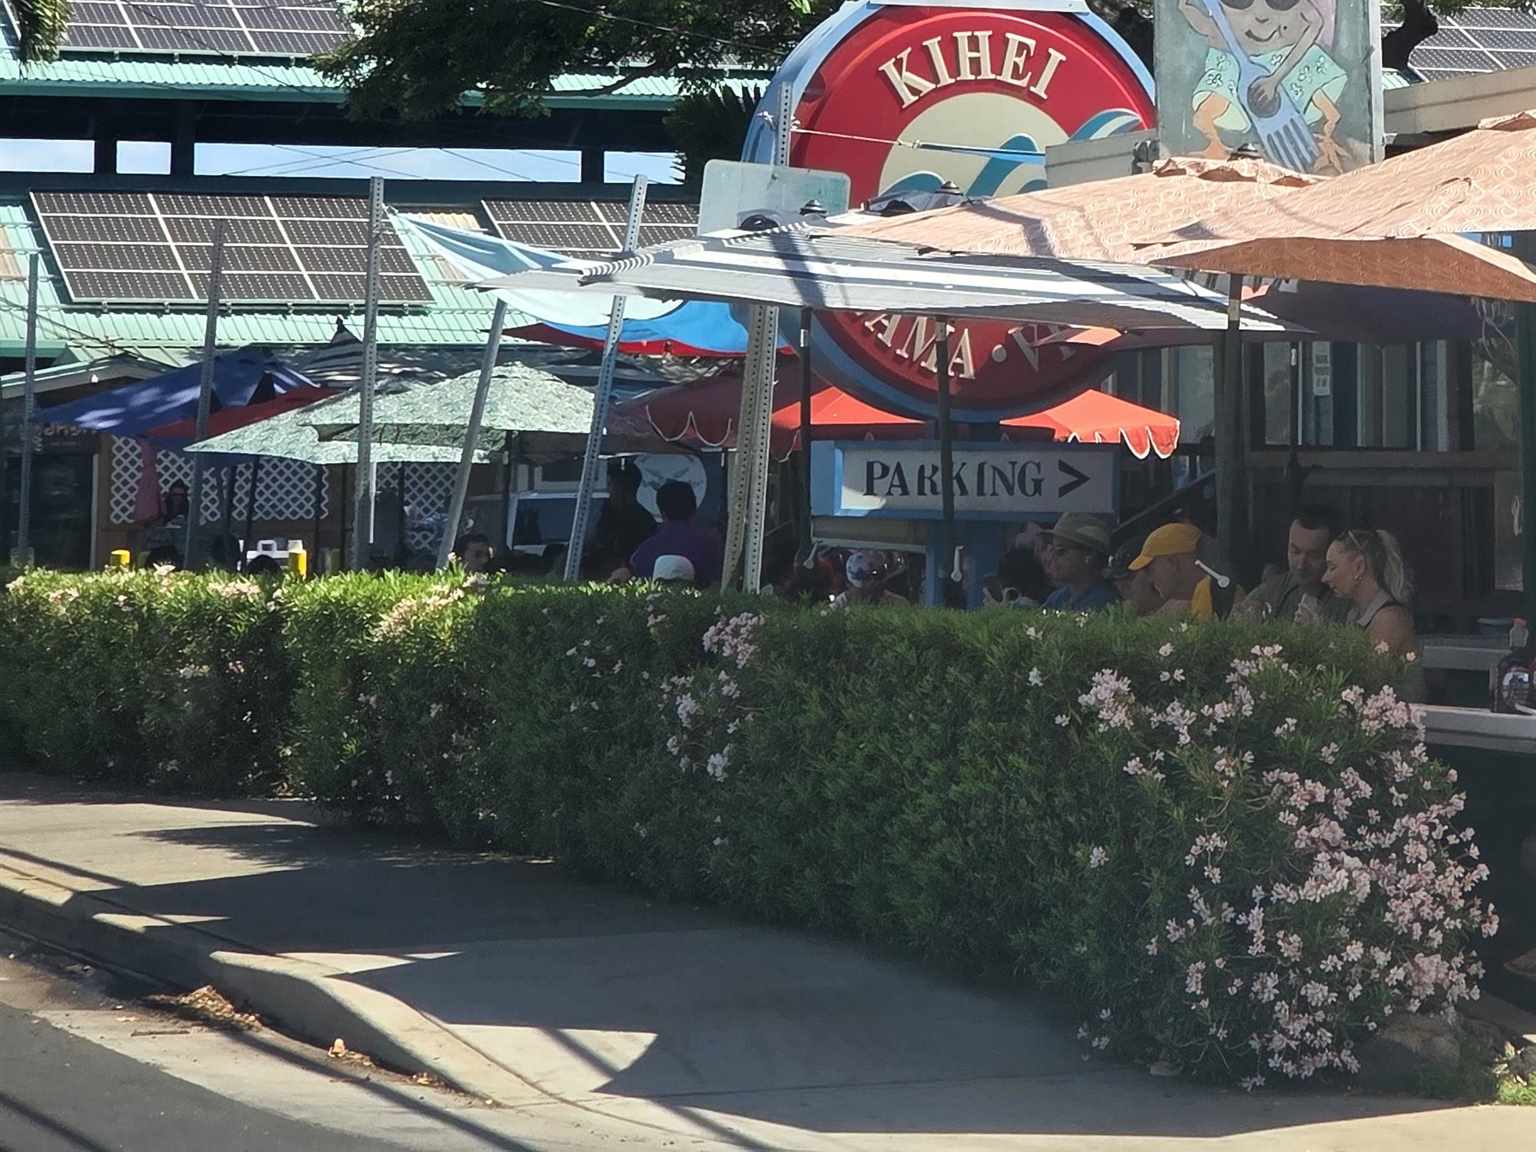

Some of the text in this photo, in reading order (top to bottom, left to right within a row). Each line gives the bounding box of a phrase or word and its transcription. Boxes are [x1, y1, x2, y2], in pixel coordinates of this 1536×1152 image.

[878, 30, 1067, 109] KIHEI
[860, 313, 977, 380] AMA
[863, 459, 1048, 499] PARKING
